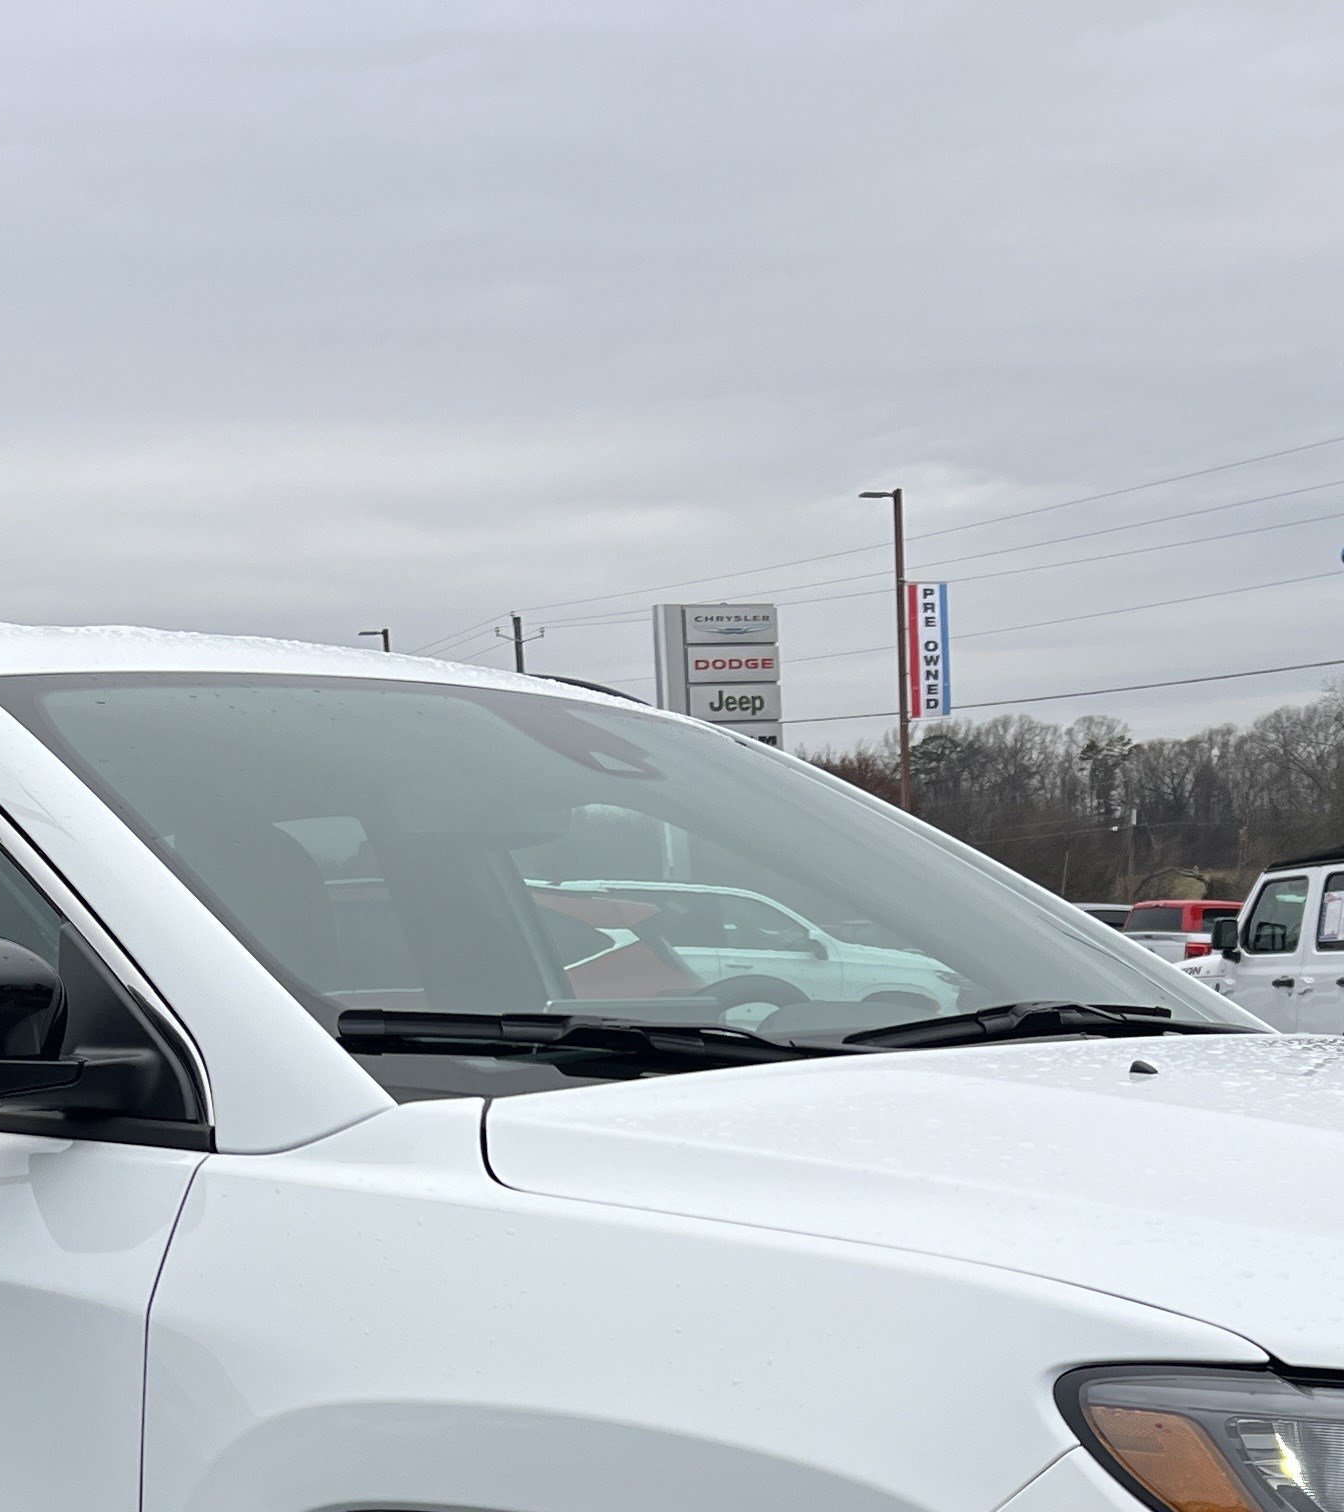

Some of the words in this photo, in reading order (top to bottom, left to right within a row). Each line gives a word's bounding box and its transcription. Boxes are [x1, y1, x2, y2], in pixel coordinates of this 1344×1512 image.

[694, 615, 770, 623] CHRYSLER
[922, 588, 937, 627] PRE
[694, 658, 774, 670] DODGE
[923, 640, 940, 710] OWNED
[709, 690, 765, 716] Jeep
